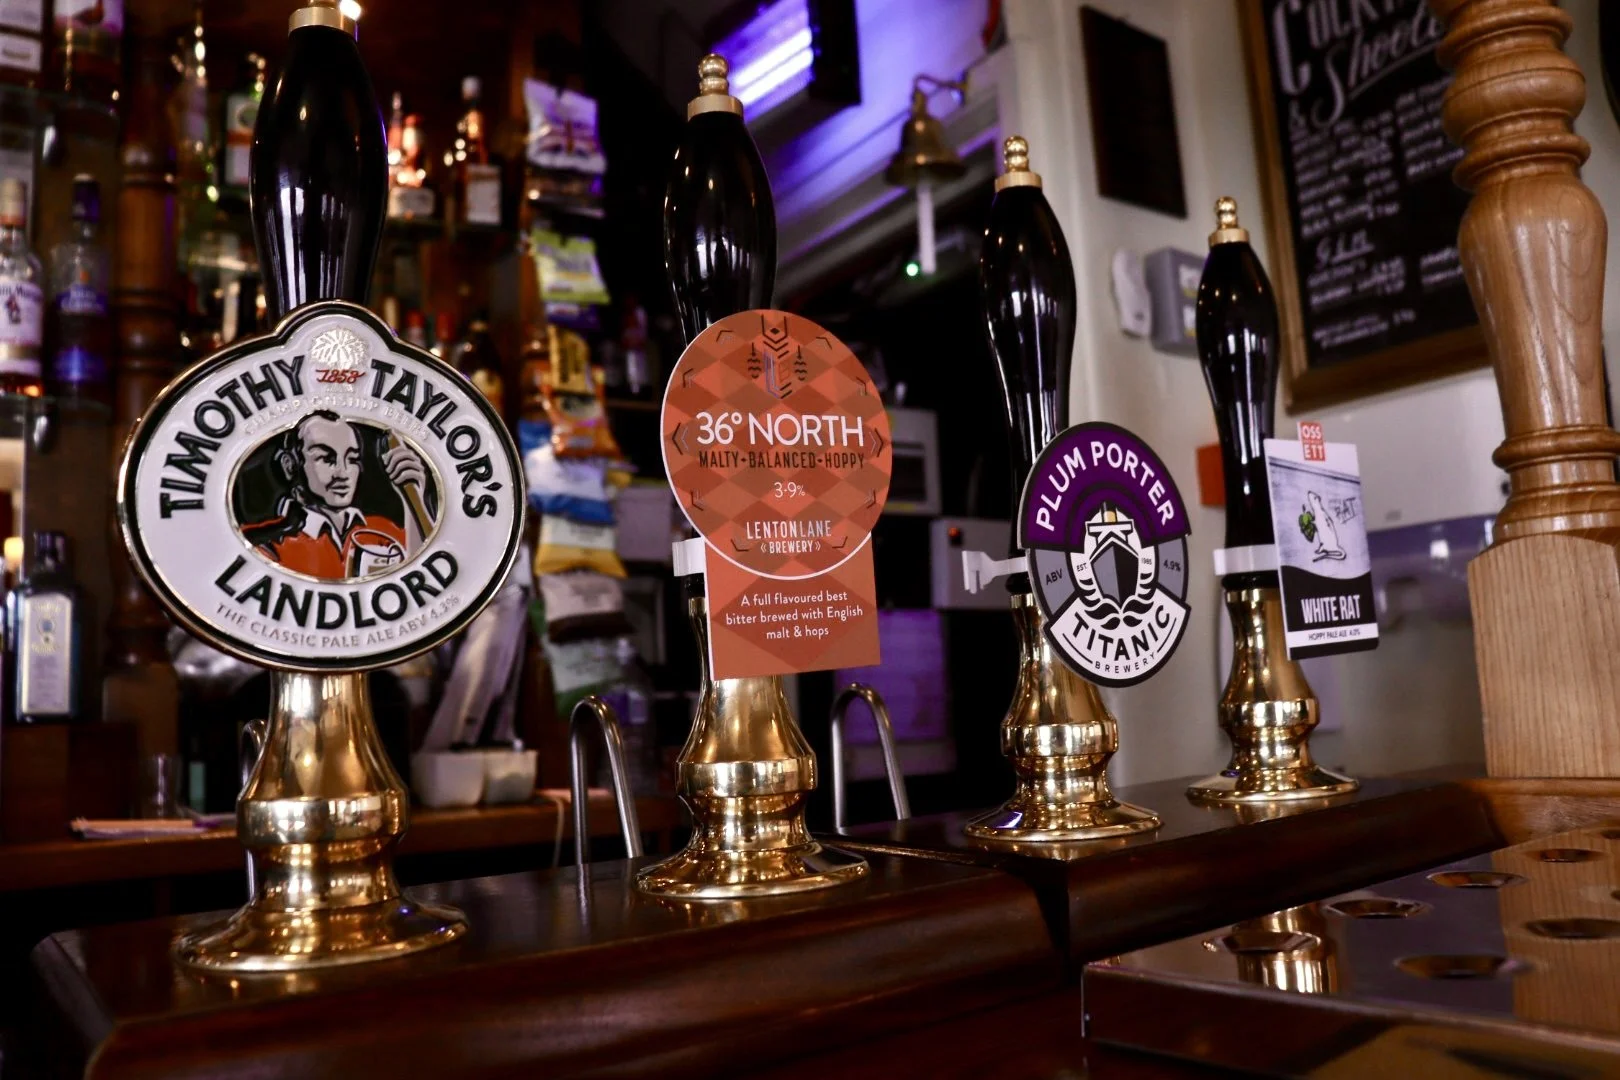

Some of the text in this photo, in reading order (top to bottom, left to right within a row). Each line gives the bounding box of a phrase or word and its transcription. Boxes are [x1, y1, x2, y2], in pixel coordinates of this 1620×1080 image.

[315, 369, 366, 384] 1858
[160, 356, 503, 520] TIMOTHY TAYLOR'S
[748, 412, 864, 447] NORTH
[699, 450, 865, 470] MALTY BALANCED HOPPY
[1036, 440, 1175, 532] PLUM PORTER
[769, 540, 813, 553] BREWERY
[1163, 559, 1182, 572] 4.9%
[1045, 567, 1063, 586] ABV
[214, 550, 459, 630] LANDLORD
[740, 590, 848, 607] A full flavoured best
[725, 605, 863, 625] bitter brewed with English
[1301, 594, 1361, 624] WHITE RAT
[215, 594, 461, 648] THE CLASSIC PALE ALE ABV 4.3%
[766, 624, 829, 640] malt & hops
[1072, 604, 1171, 662] TITANIC
[1094, 651, 1157, 674] BREWERY
